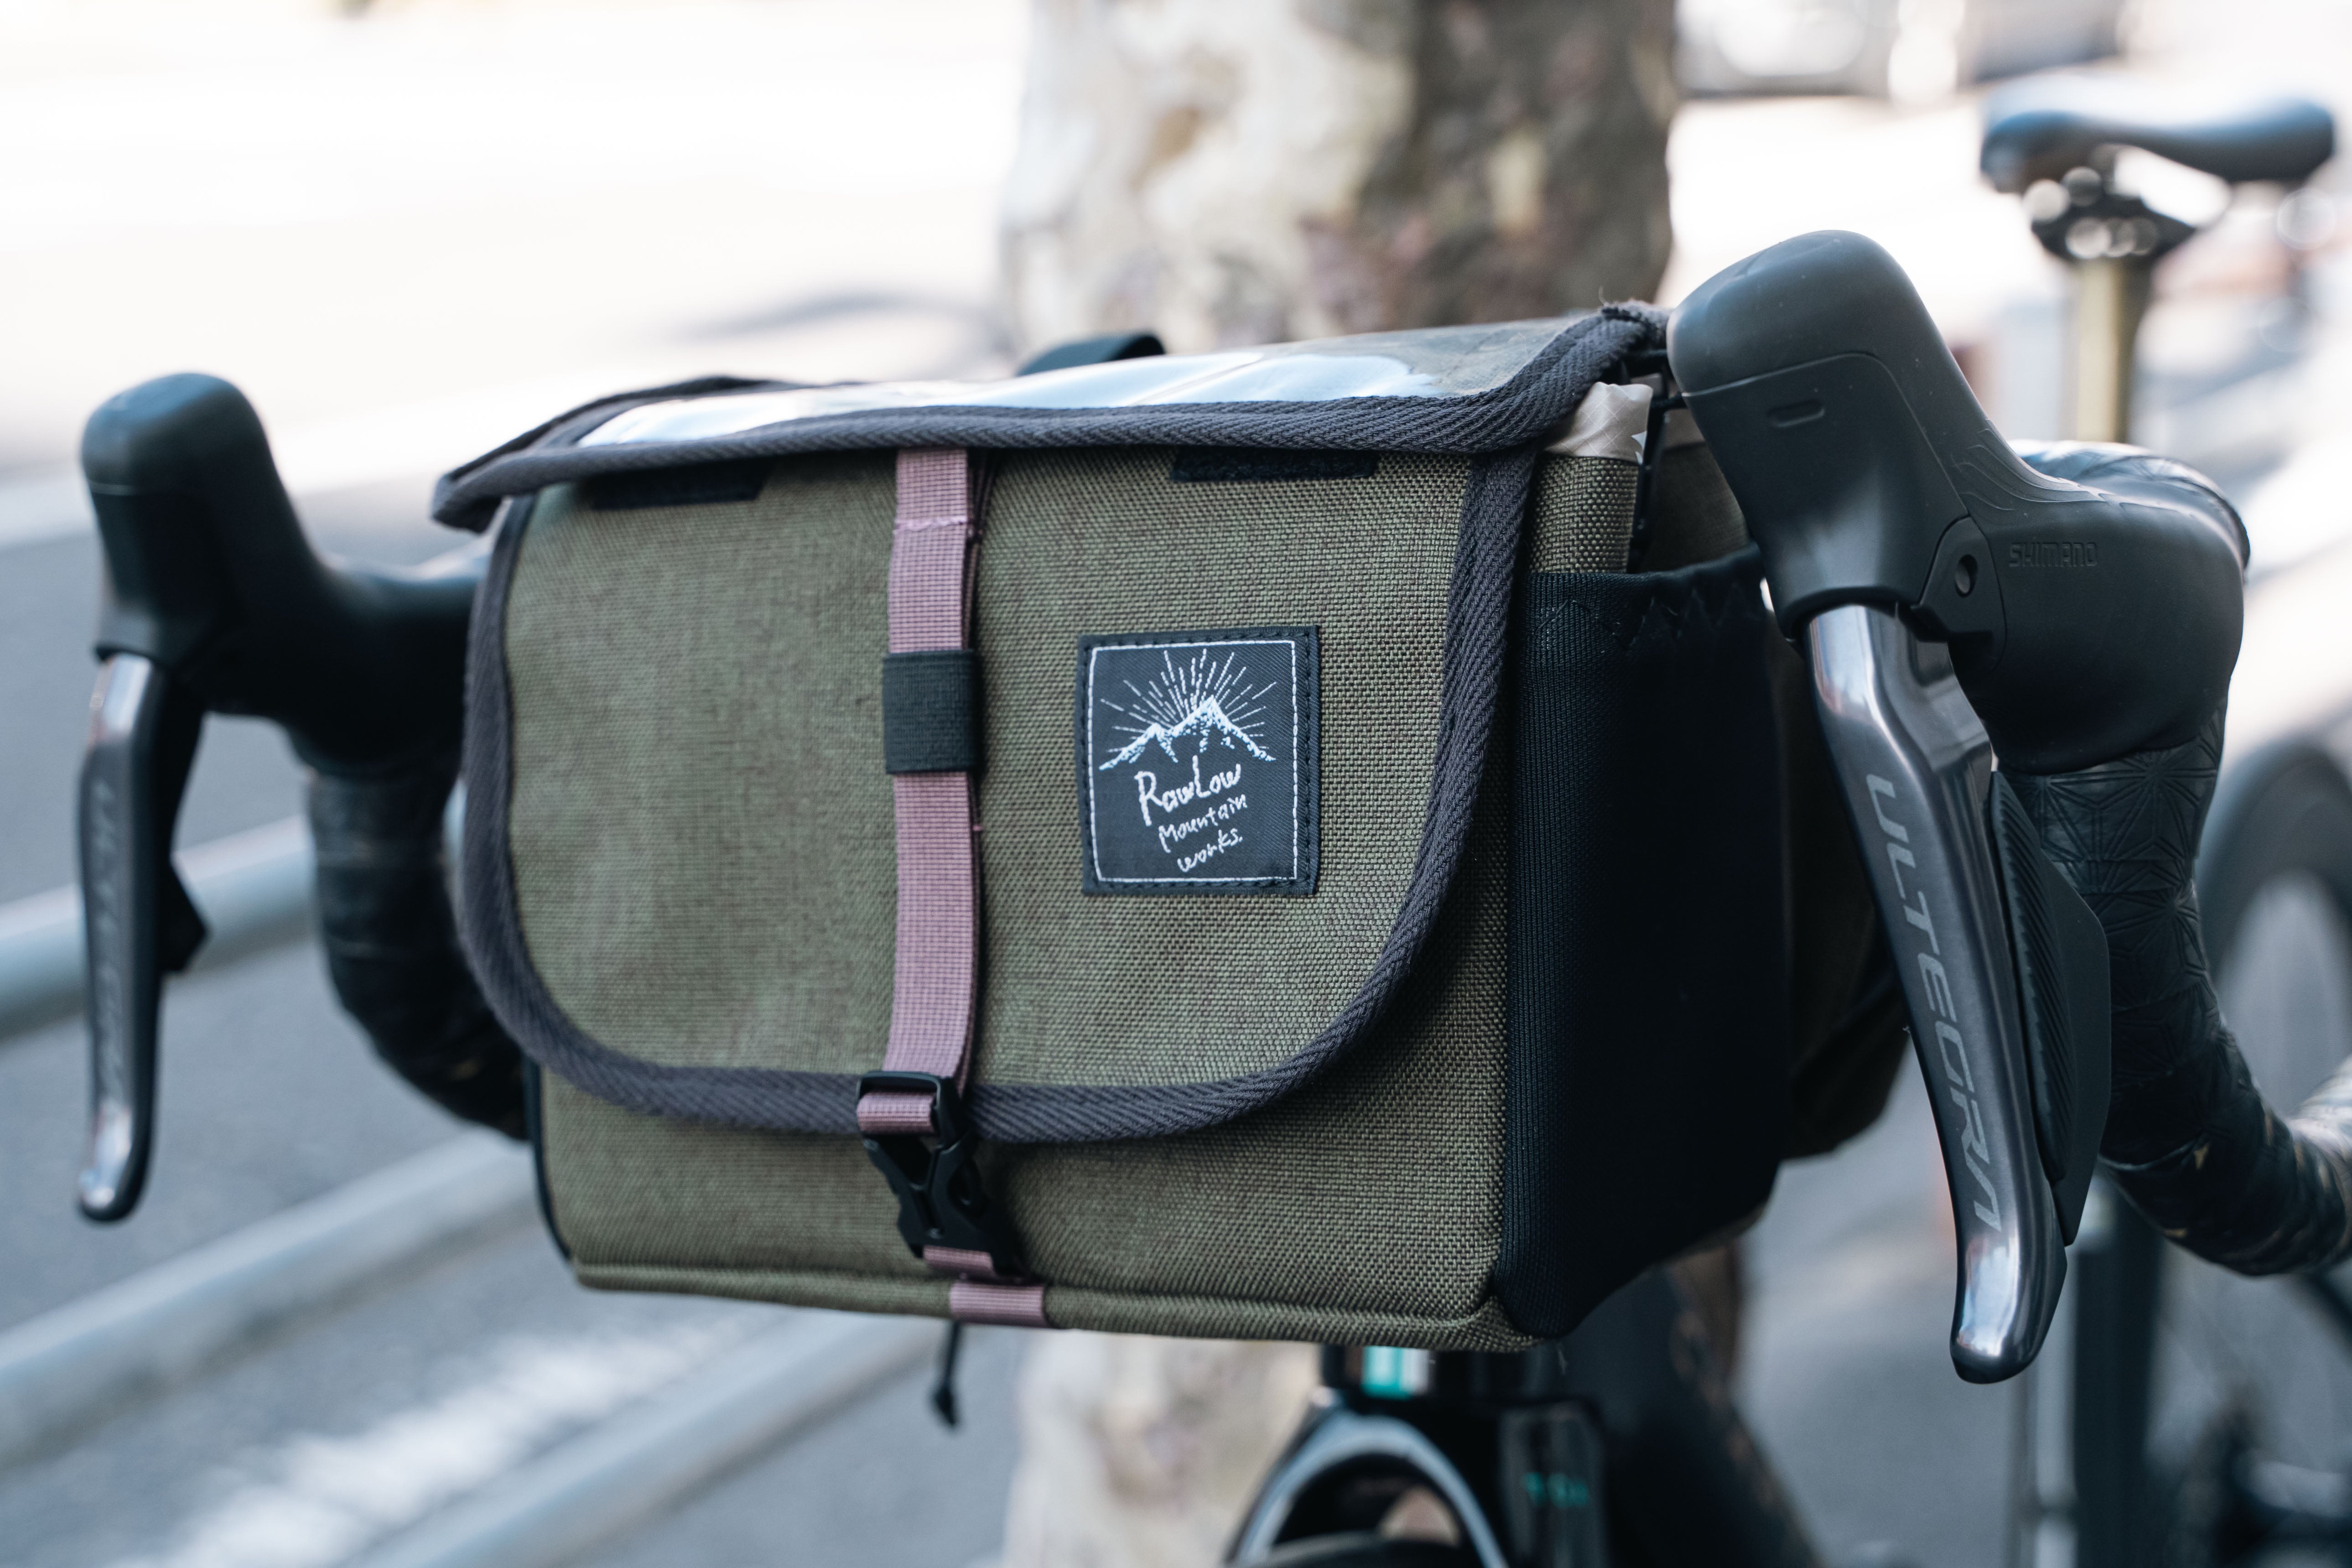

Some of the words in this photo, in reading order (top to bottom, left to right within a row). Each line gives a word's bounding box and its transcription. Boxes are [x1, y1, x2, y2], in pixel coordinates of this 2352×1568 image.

[2009, 542, 2098, 567] SHIMANO
[1134, 755, 1241, 826] RawLow
[1158, 794, 1248, 854] Mountain
[1865, 773, 2002, 1231] ULTEGRA
